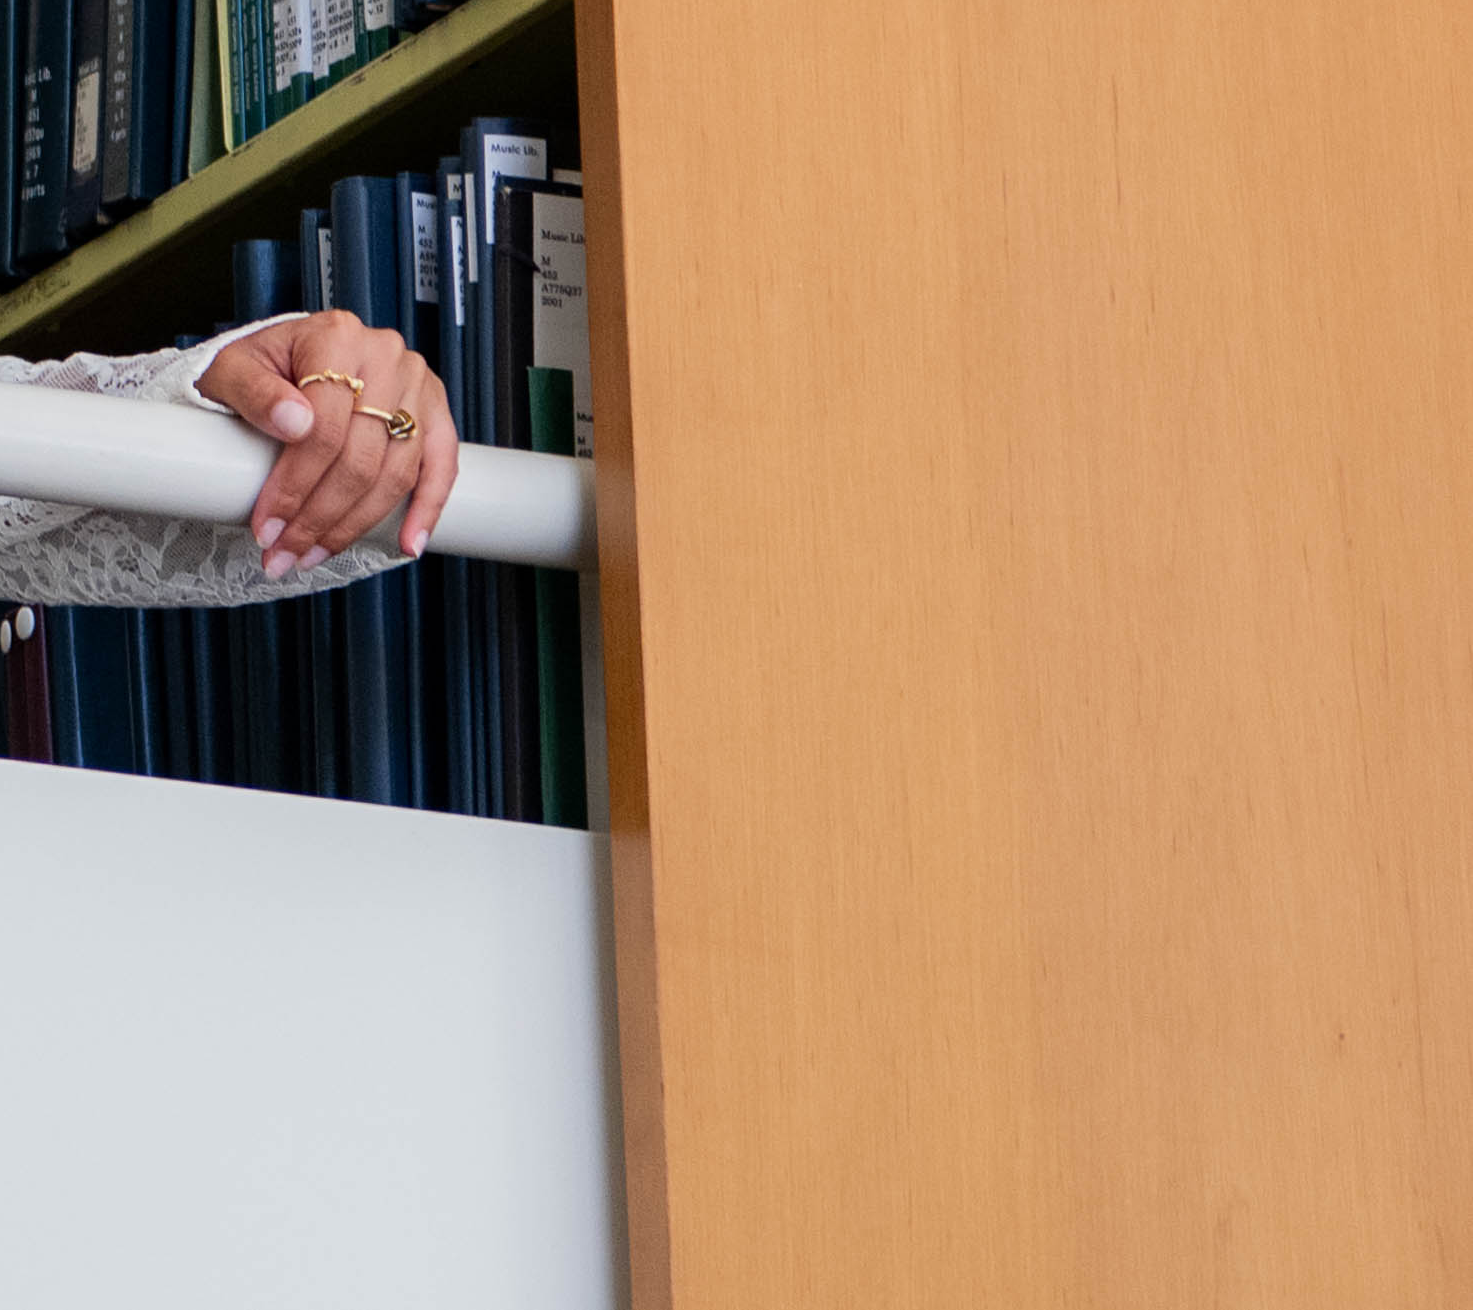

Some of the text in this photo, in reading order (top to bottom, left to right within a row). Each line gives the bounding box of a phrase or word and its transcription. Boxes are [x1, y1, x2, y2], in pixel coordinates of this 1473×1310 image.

[490, 143, 540, 158] Music Lib.
[418, 224, 426, 233] M
[540, 229, 570, 245] Music
[540, 255, 551, 266] M
[540, 296, 563, 309] 2001
